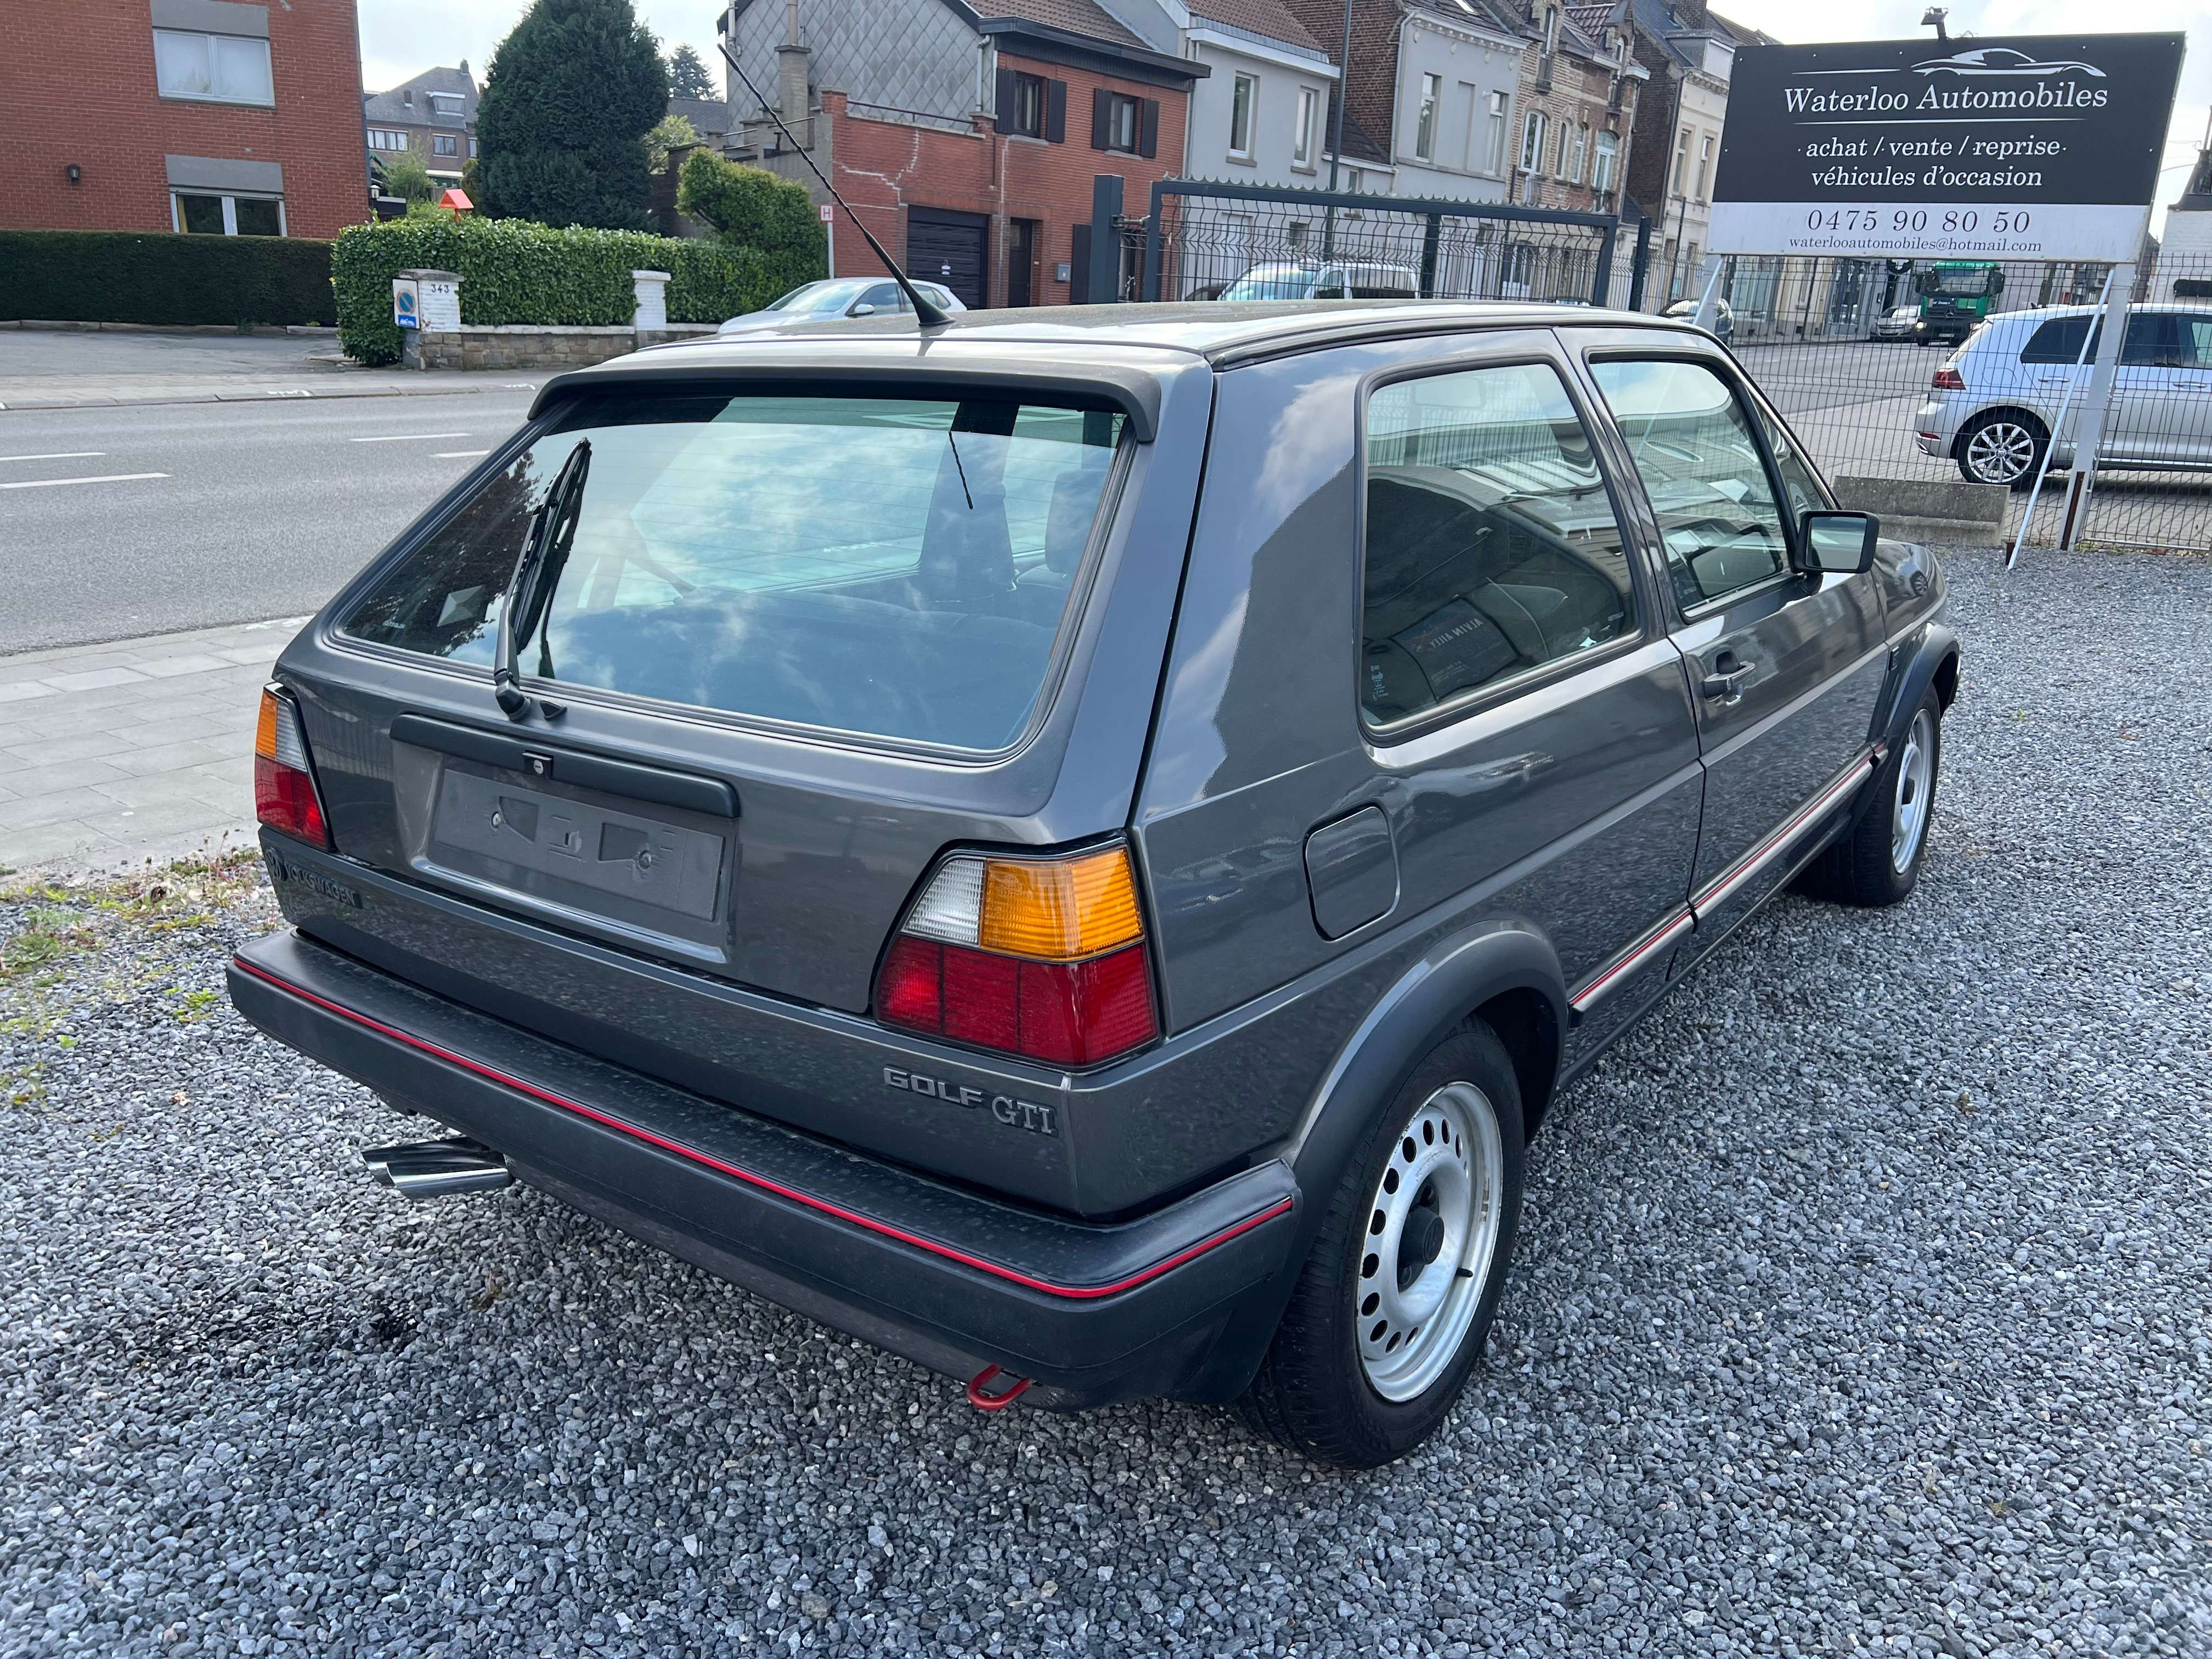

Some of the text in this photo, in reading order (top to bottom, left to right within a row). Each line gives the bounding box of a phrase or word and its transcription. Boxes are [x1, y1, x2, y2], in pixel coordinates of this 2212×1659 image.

[1784, 82, 2108, 113] Waterloo Automobiles
[1805, 137, 1868, 157] achat
[1889, 137, 1953, 156] vente
[1973, 134, 2061, 160] reprise
[1812, 166, 1916, 187] véhicules
[823, 207, 831, 219] H
[1808, 210, 2030, 233] 0475 90 80 50
[1789, 235, 2042, 252] waterlooautomobiles@hotmail.com
[431, 284, 449, 294] 343
[284, 861, 356, 907] VOLKSWAGEN
[883, 1067, 1052, 1134] GOLF GTI
